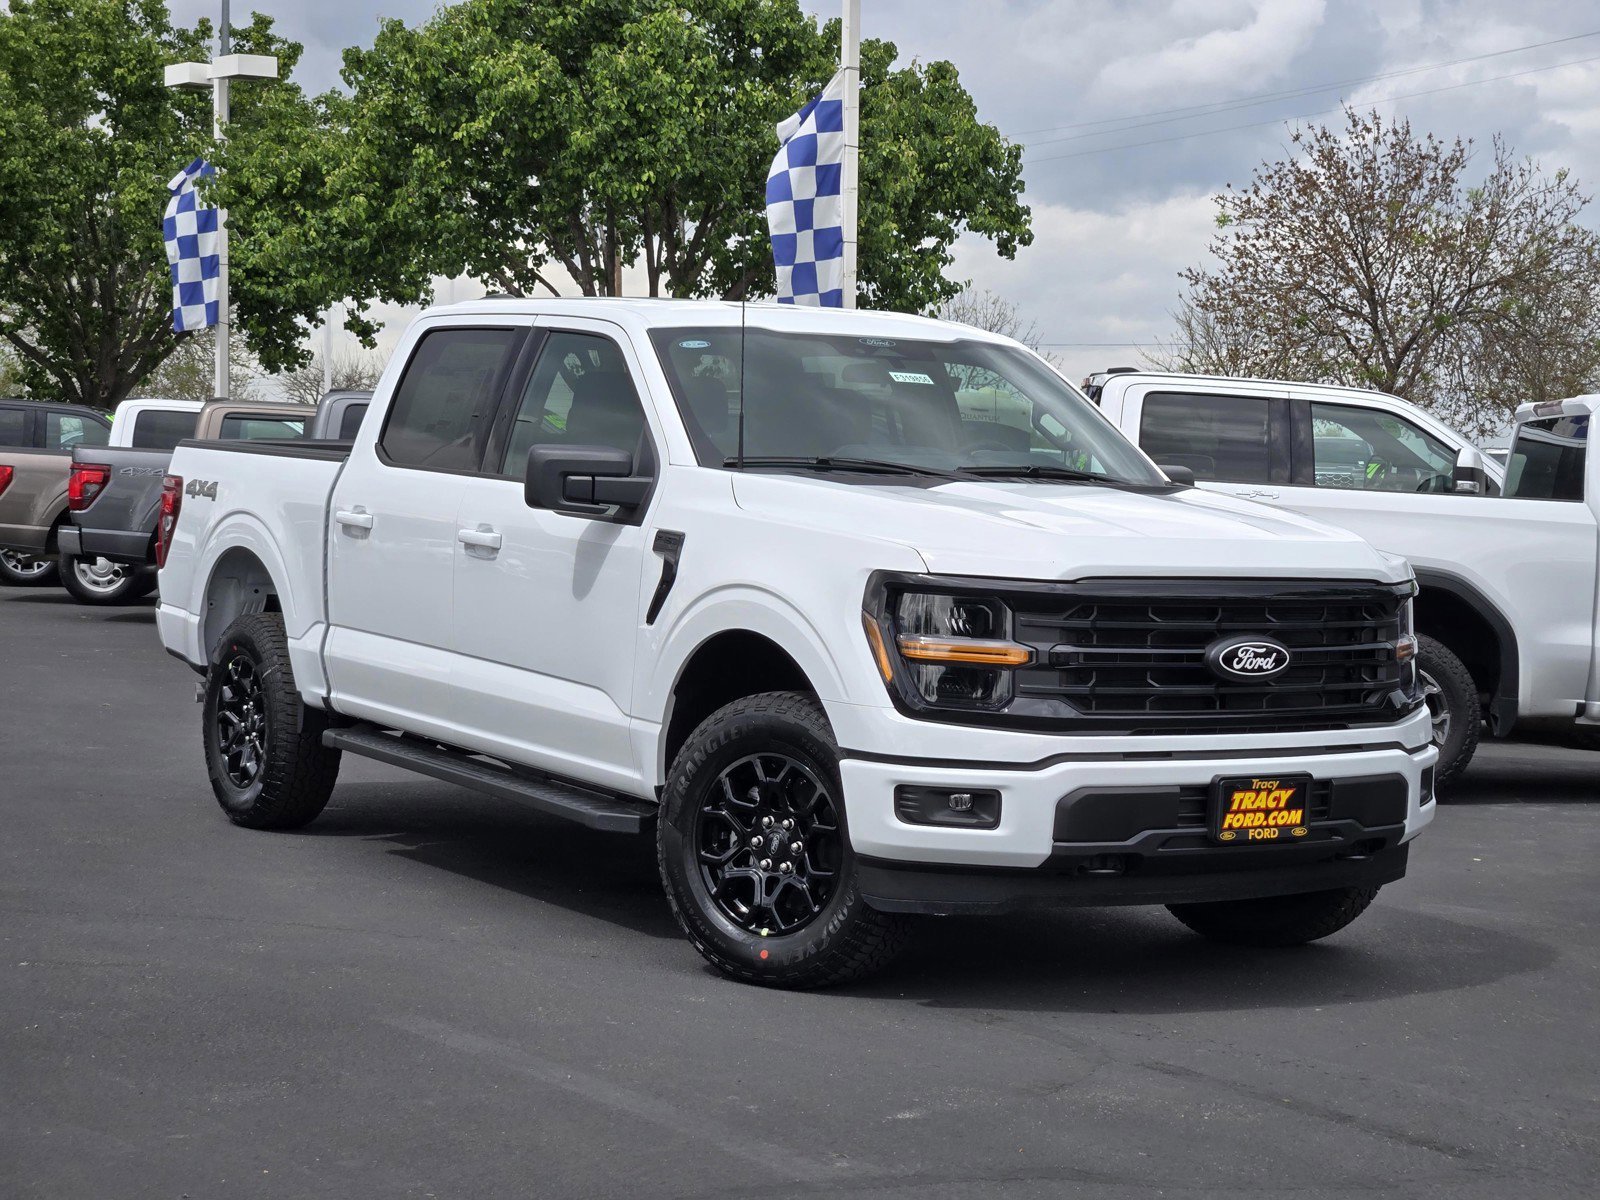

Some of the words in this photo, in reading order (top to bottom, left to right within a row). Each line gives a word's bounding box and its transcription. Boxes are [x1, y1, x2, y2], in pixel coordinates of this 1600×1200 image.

[1233, 647, 1277, 669] Ford
[1252, 779, 1279, 790] Tracy
[1231, 789, 1295, 810] TRACY
[1223, 809, 1302, 828] FORD.COM
[1248, 828, 1279, 840] FORD
